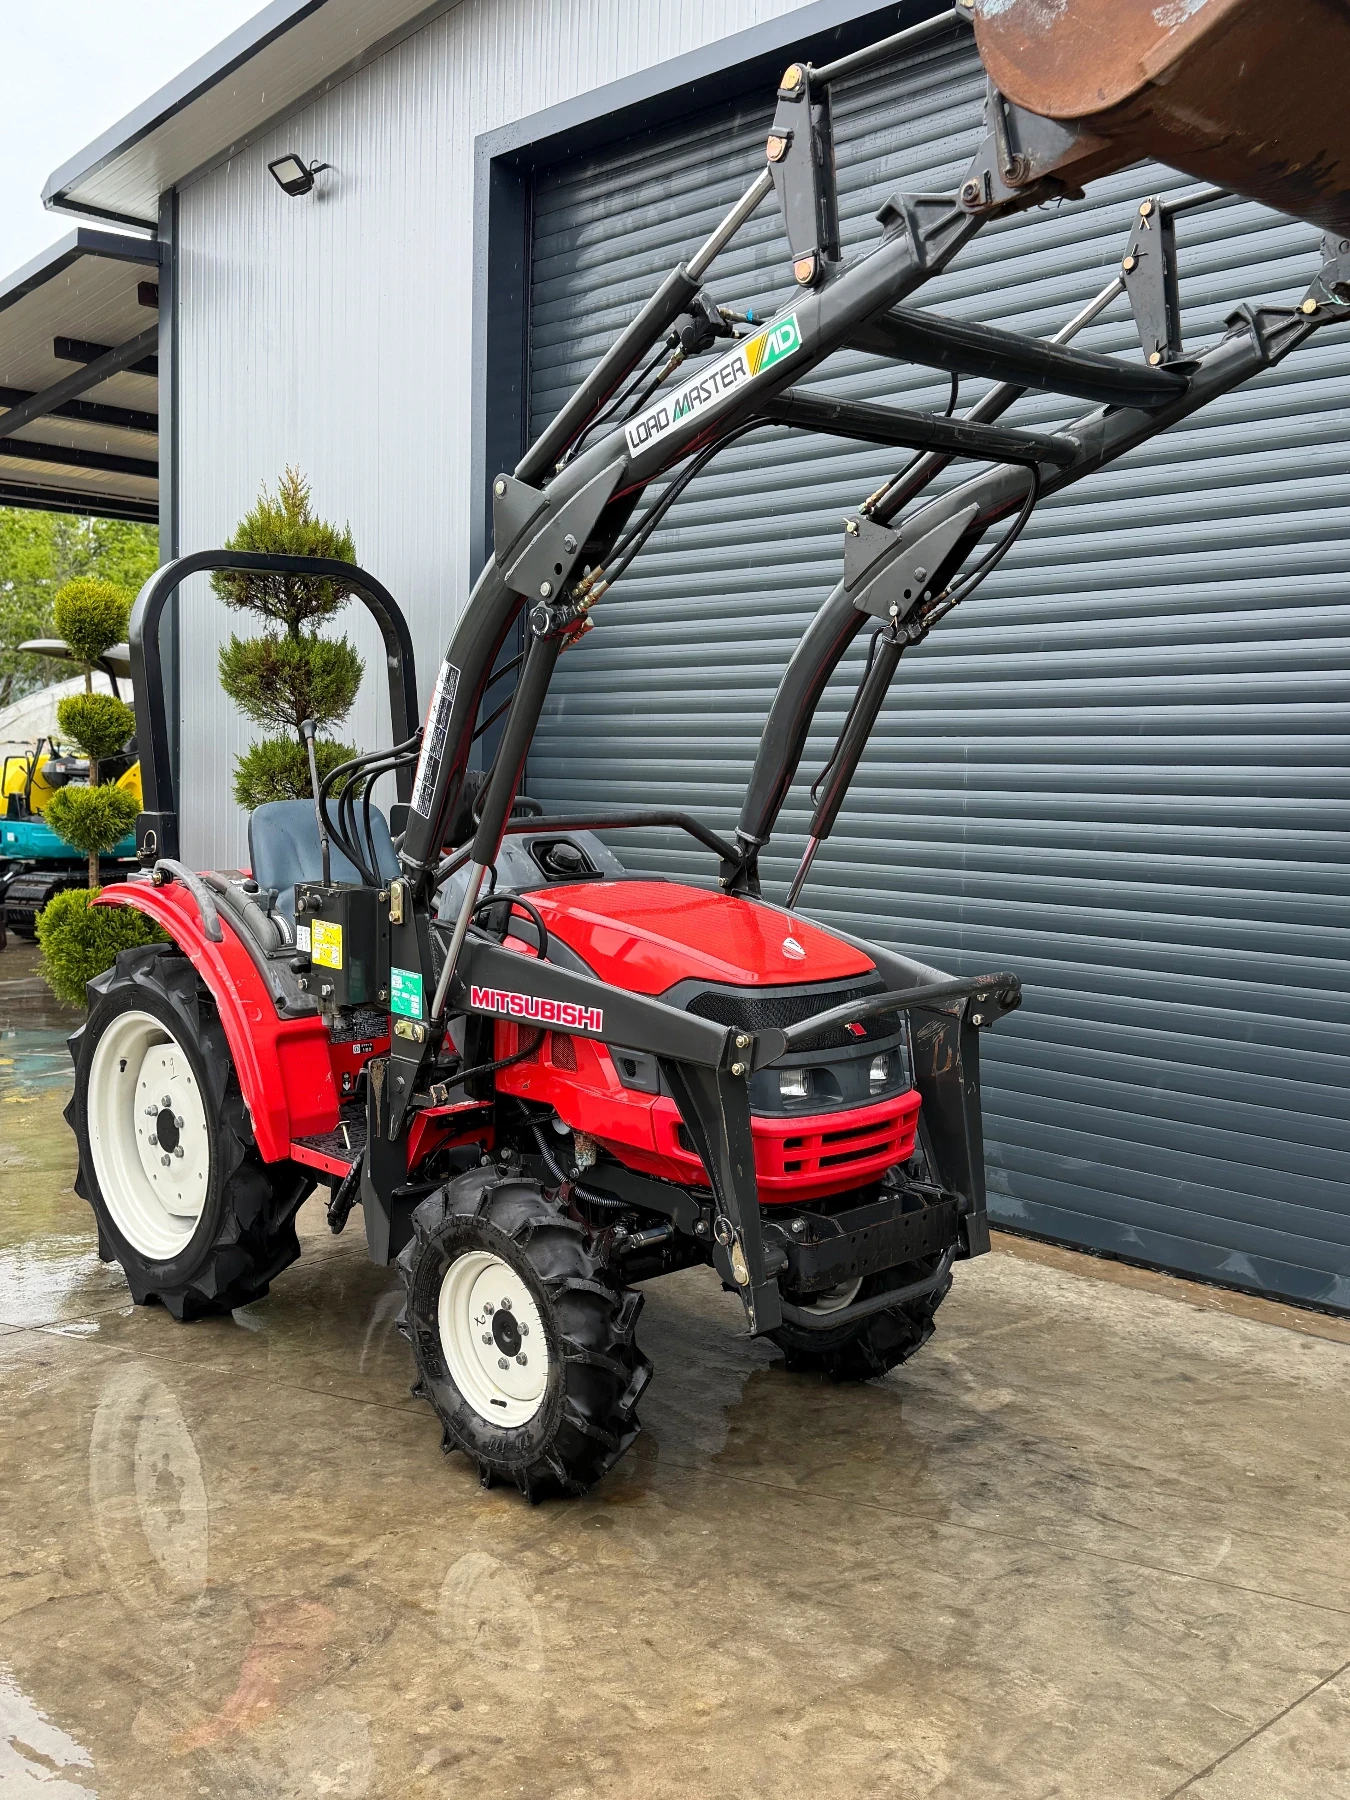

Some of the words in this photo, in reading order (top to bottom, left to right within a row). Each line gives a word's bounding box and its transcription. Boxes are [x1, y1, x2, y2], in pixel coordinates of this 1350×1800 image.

[628, 407, 670, 449] LOAD
[672, 356, 747, 423] MASTER
[470, 985, 603, 1032] MITSUBISHI
